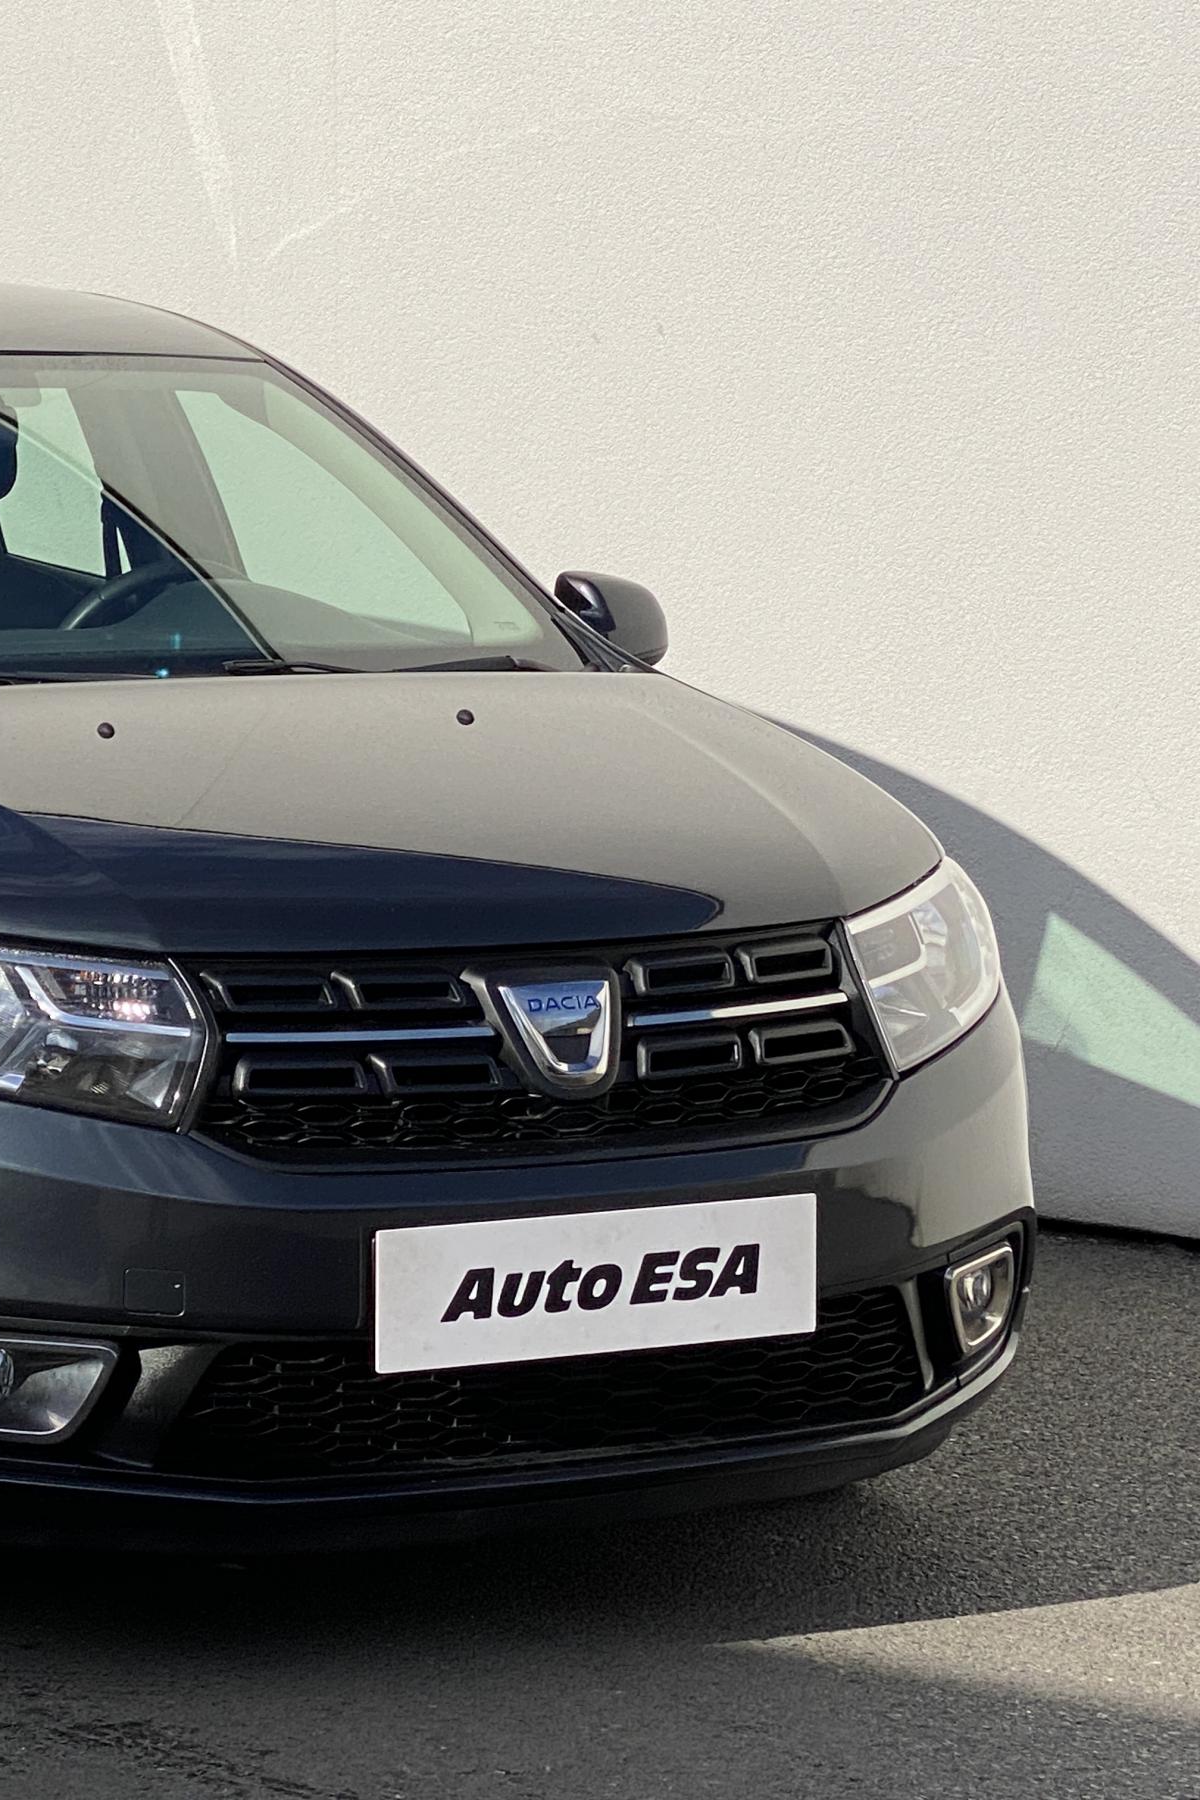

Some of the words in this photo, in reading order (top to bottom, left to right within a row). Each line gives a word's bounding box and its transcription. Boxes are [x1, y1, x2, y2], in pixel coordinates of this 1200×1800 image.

[527, 995, 600, 1012] DACIA
[440, 1260, 622, 1322] Auto
[629, 1243, 760, 1305] ESA
